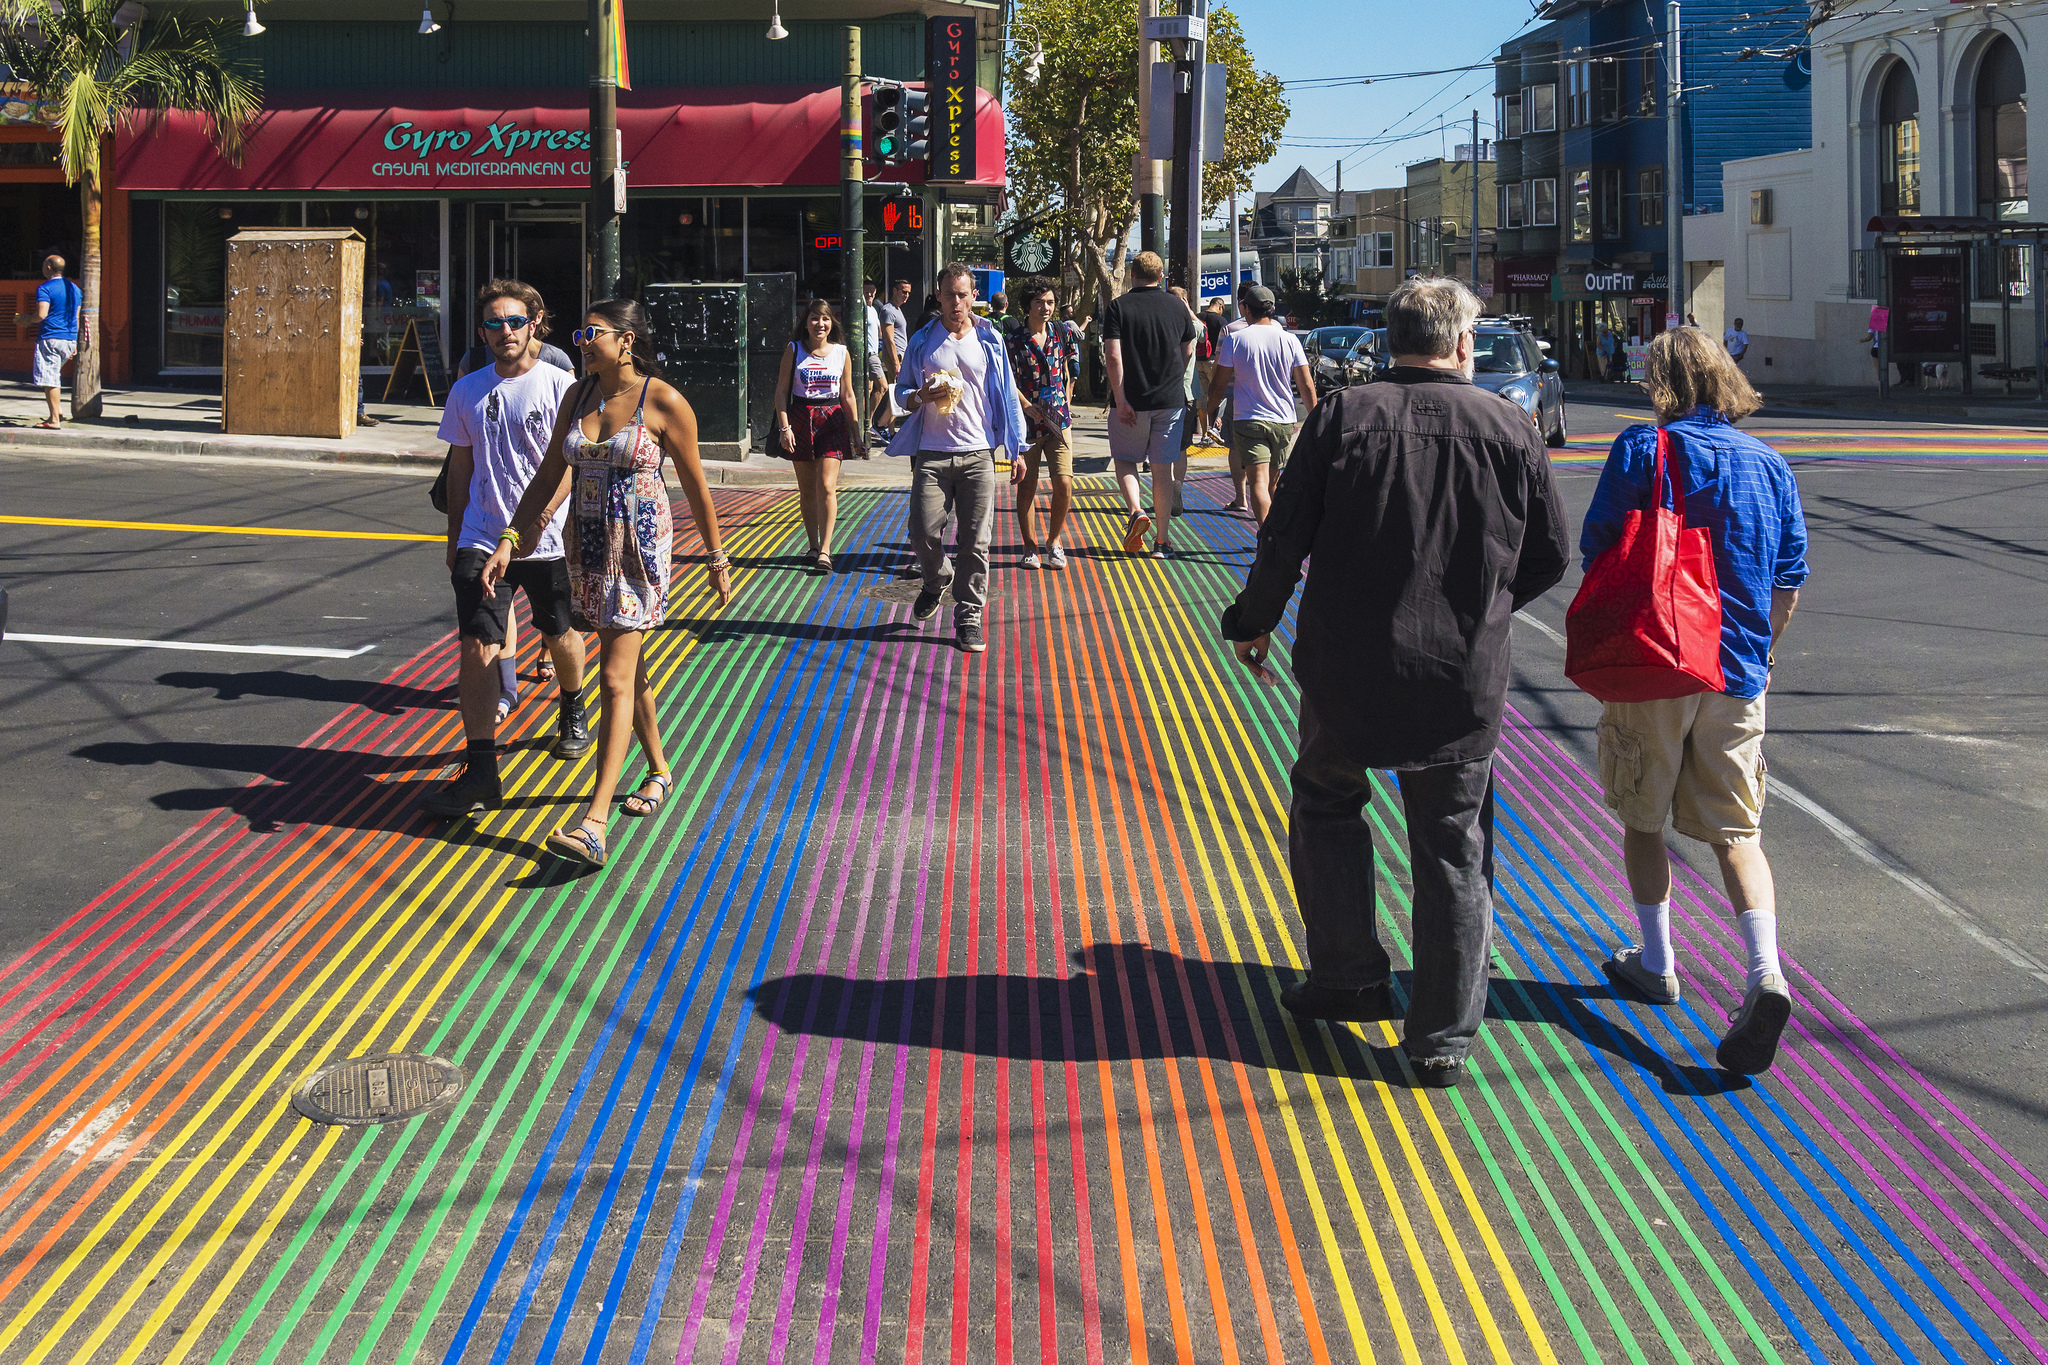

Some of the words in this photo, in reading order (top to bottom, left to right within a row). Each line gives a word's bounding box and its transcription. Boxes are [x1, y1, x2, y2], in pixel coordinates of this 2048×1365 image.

[946, 22, 963, 80] Gyro
[946, 86, 964, 175] Xpress
[383, 122, 472, 159] Gyro
[372, 162, 430, 176] CASUAL
[436, 161, 565, 176] MEDITERRANEAN
[908, 204, 923, 229] 16
[815, 236, 841, 249] OP
[1201, 274, 1229, 290] dget
[1513, 273, 1549, 281] PHARMACY
[1562, 283, 1585, 292] PIZZ
[178, 315, 225, 327] HUMMU
